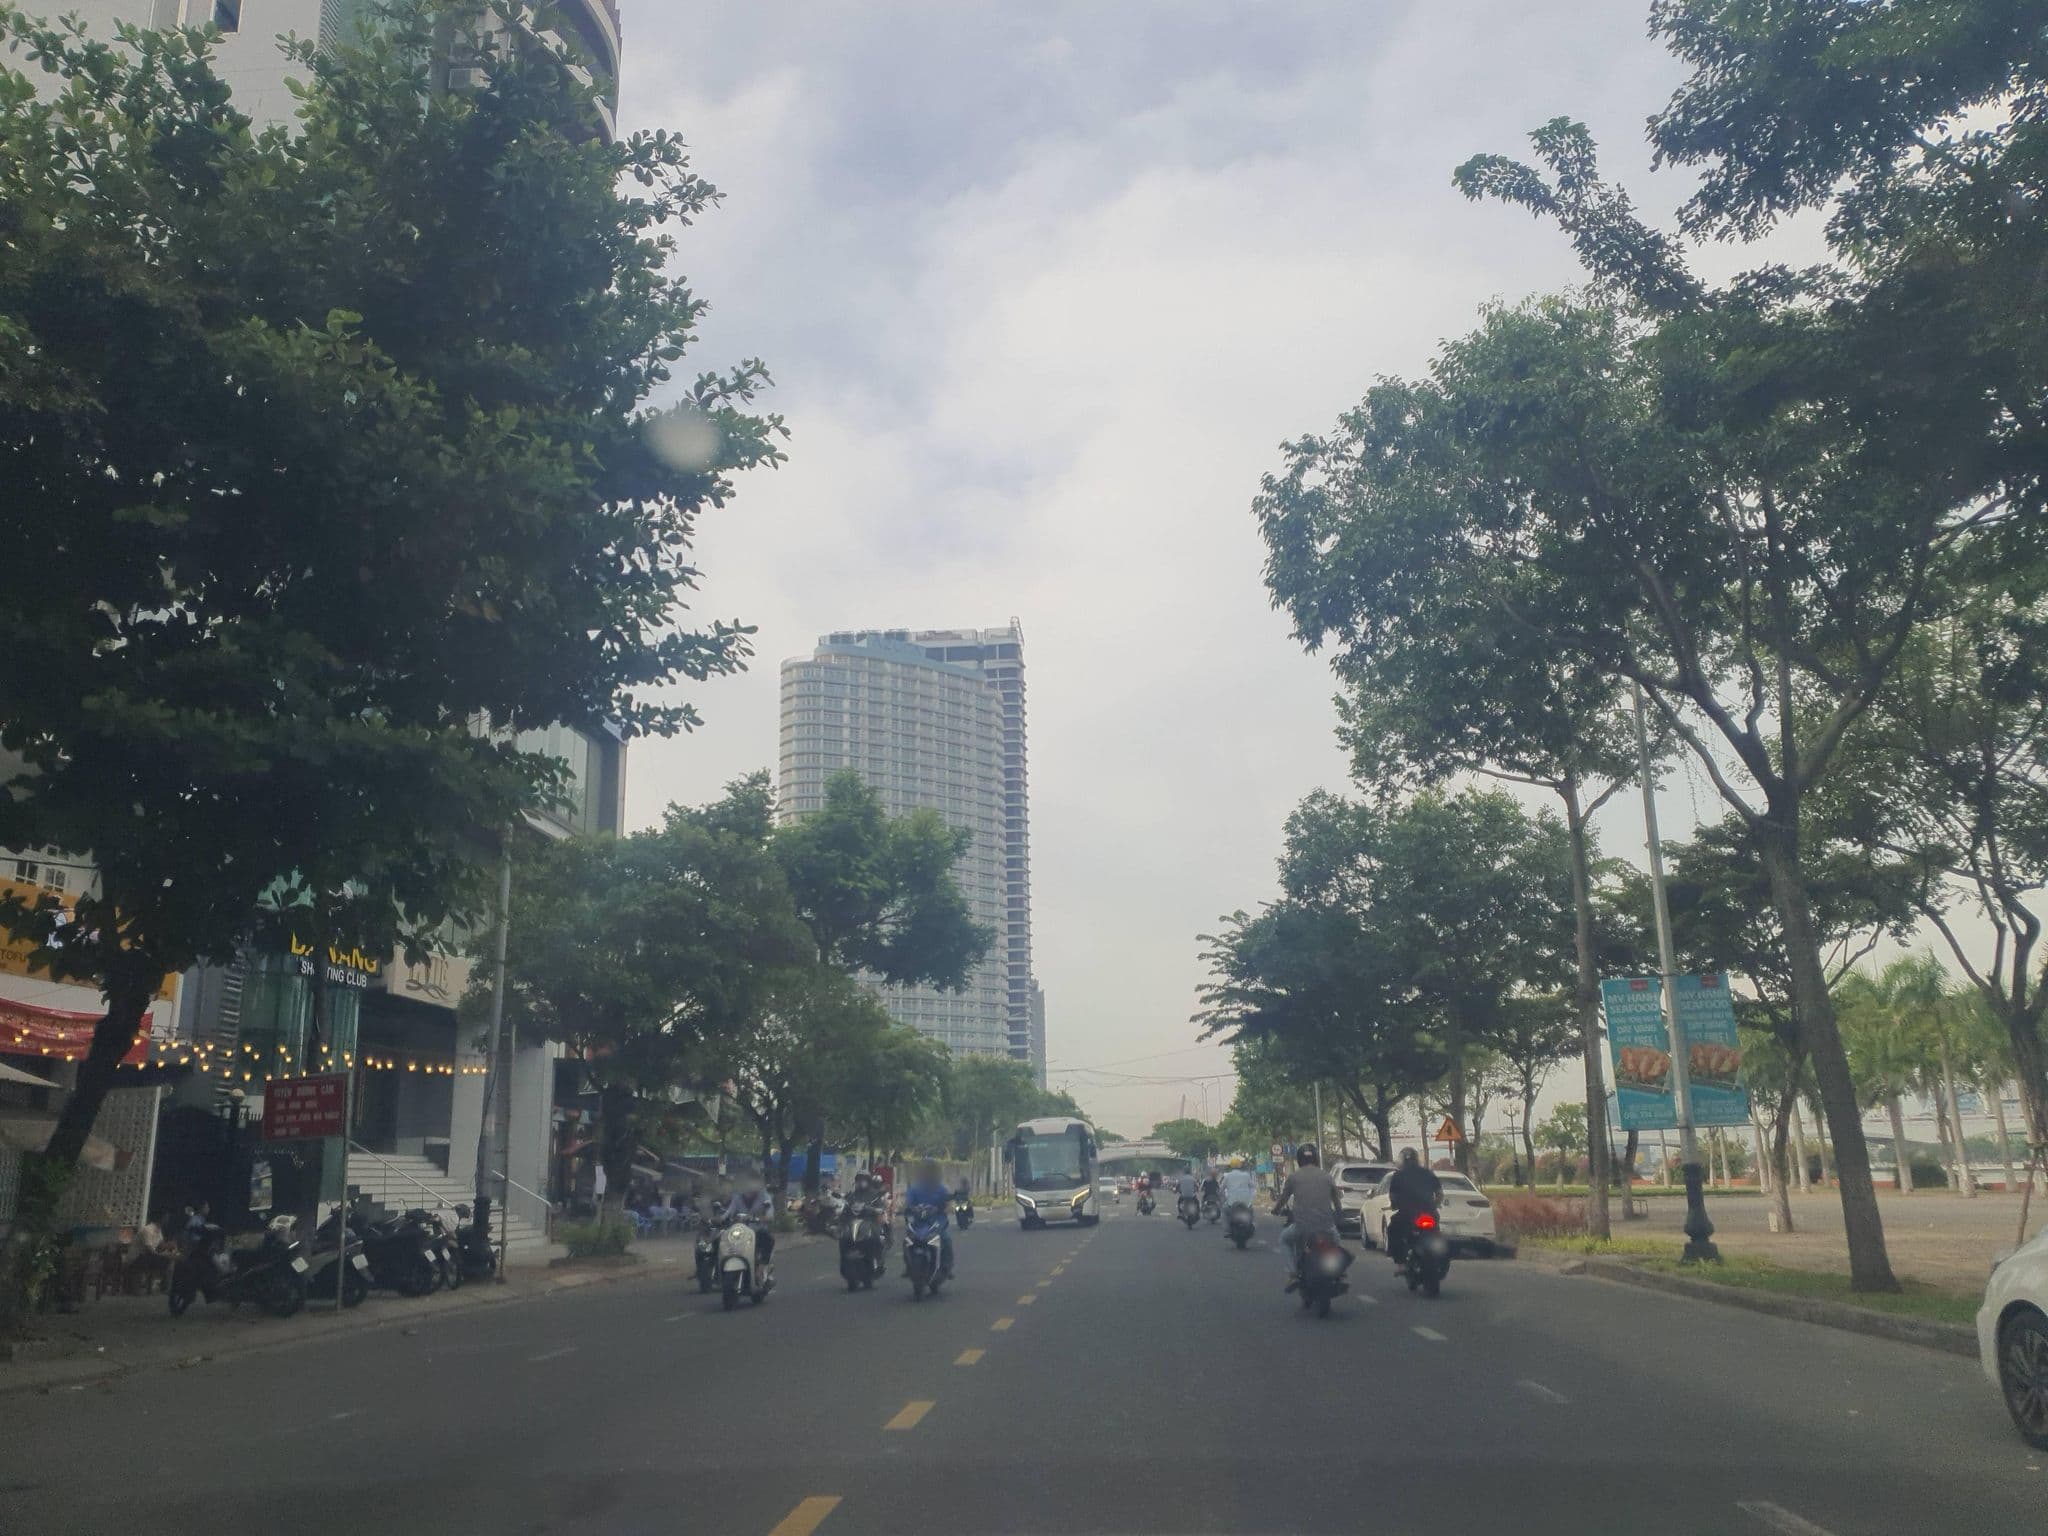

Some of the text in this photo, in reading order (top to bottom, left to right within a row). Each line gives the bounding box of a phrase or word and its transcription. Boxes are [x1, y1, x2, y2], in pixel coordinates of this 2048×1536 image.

[301, 960, 367, 987] SHTING CLUB
[1610, 1001, 1659, 1014] SEAFOOD
